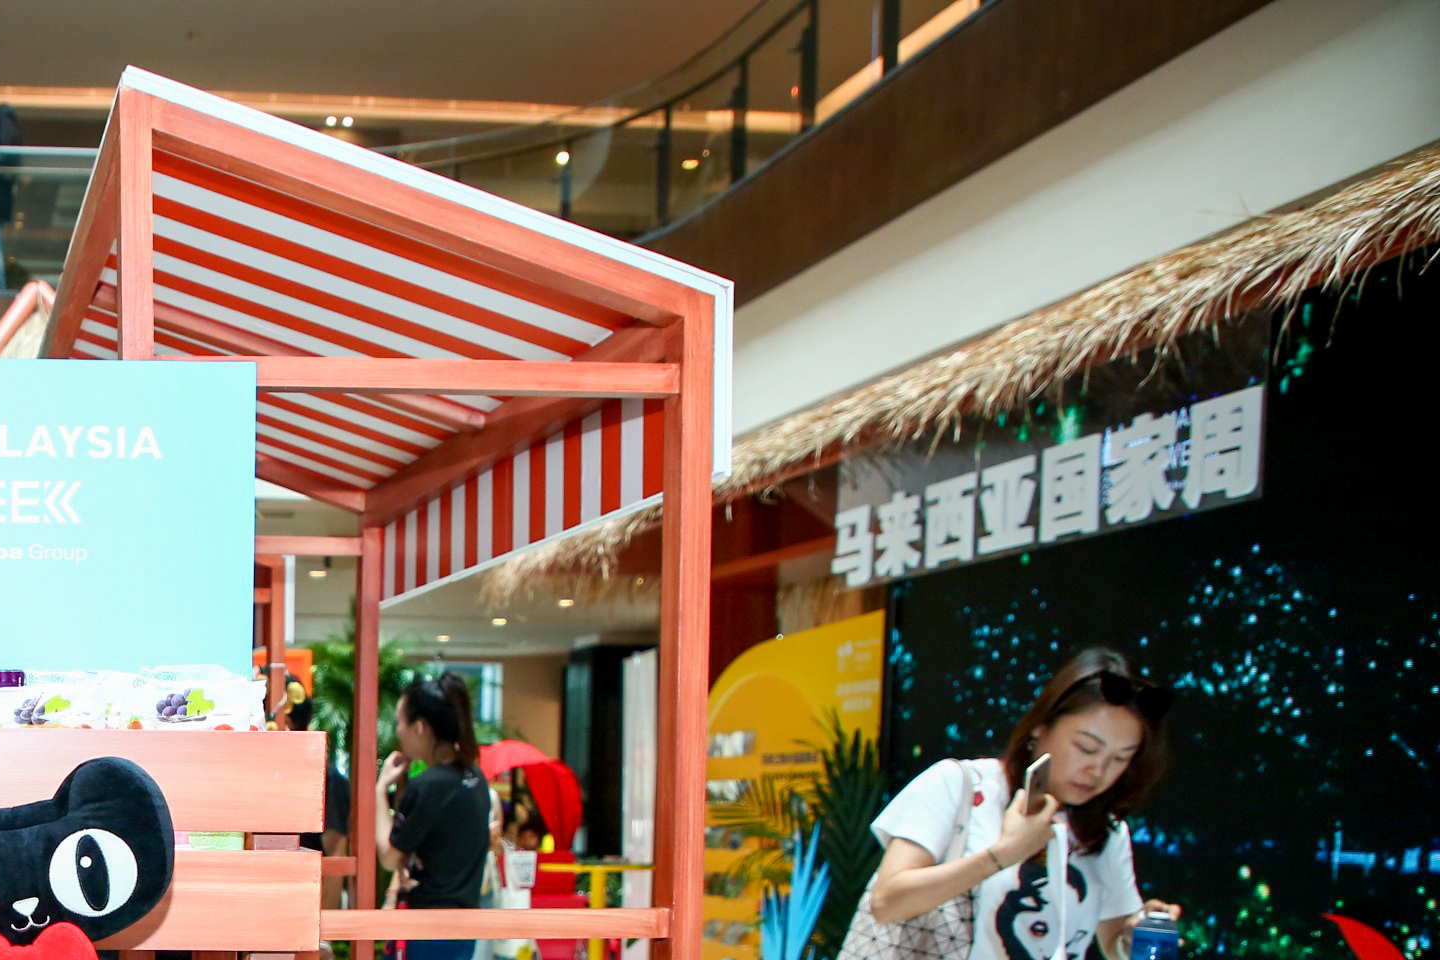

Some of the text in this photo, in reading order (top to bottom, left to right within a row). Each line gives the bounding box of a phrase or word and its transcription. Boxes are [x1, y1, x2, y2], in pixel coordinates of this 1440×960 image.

[831, 384, 1264, 587] 马来西亚国家周
[28, 543, 88, 564] Group
